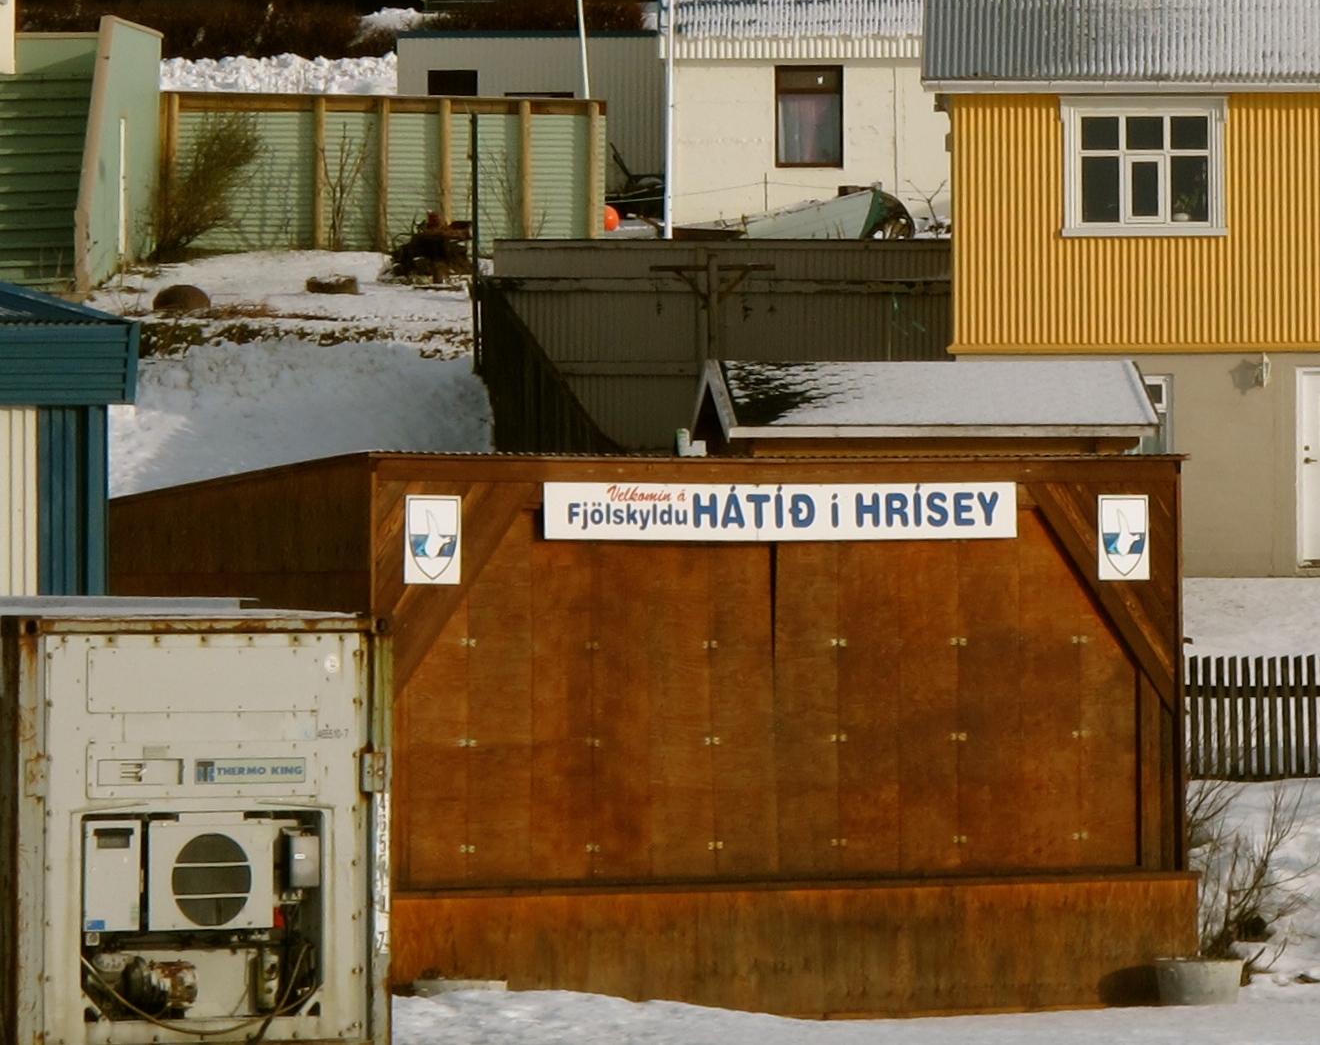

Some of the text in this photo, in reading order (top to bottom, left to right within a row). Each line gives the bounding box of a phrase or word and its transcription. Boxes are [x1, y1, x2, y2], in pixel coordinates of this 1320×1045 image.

[606, 485, 687, 503] Velkomin á
[567, 483, 999, 531] Fjölskyldu HÁTÍÐ í HRÍSEY
[216, 765, 303, 776] THERMO KING
